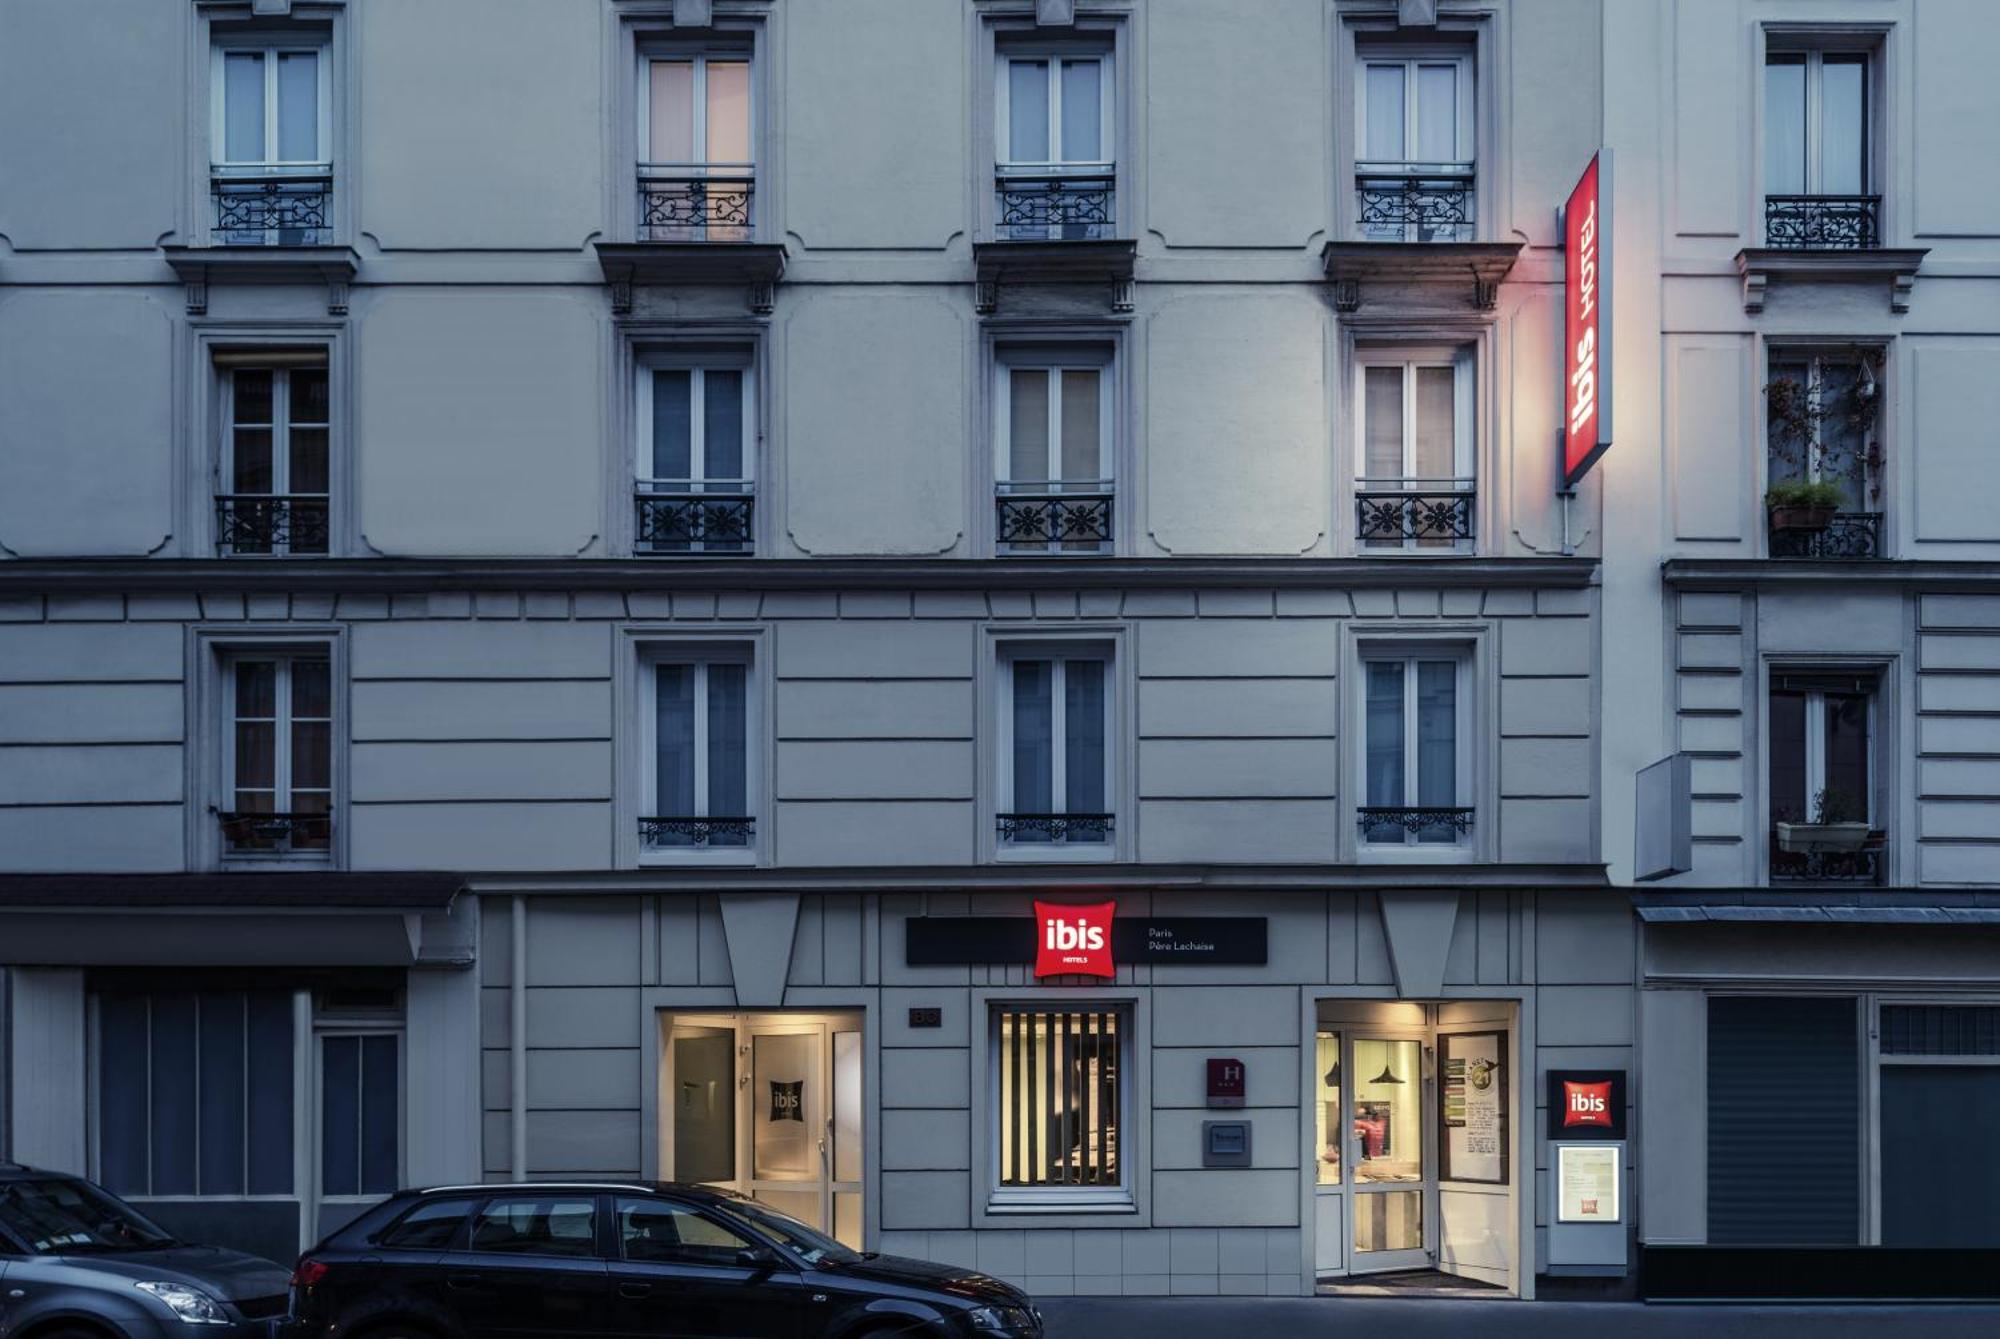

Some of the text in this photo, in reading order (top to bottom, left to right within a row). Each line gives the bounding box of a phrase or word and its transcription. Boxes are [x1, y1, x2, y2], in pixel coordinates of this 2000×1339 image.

[1571, 200, 1595, 435] ibis HOTEL
[1047, 919, 1104, 951] ibis
[1149, 928, 1173, 937] Paris
[1174, 940, 1215, 950] Lachaise
[1062, 956, 1088, 964] HOTELS
[775, 1091, 799, 1108] ibis
[1571, 1093, 1605, 1112] ibis
